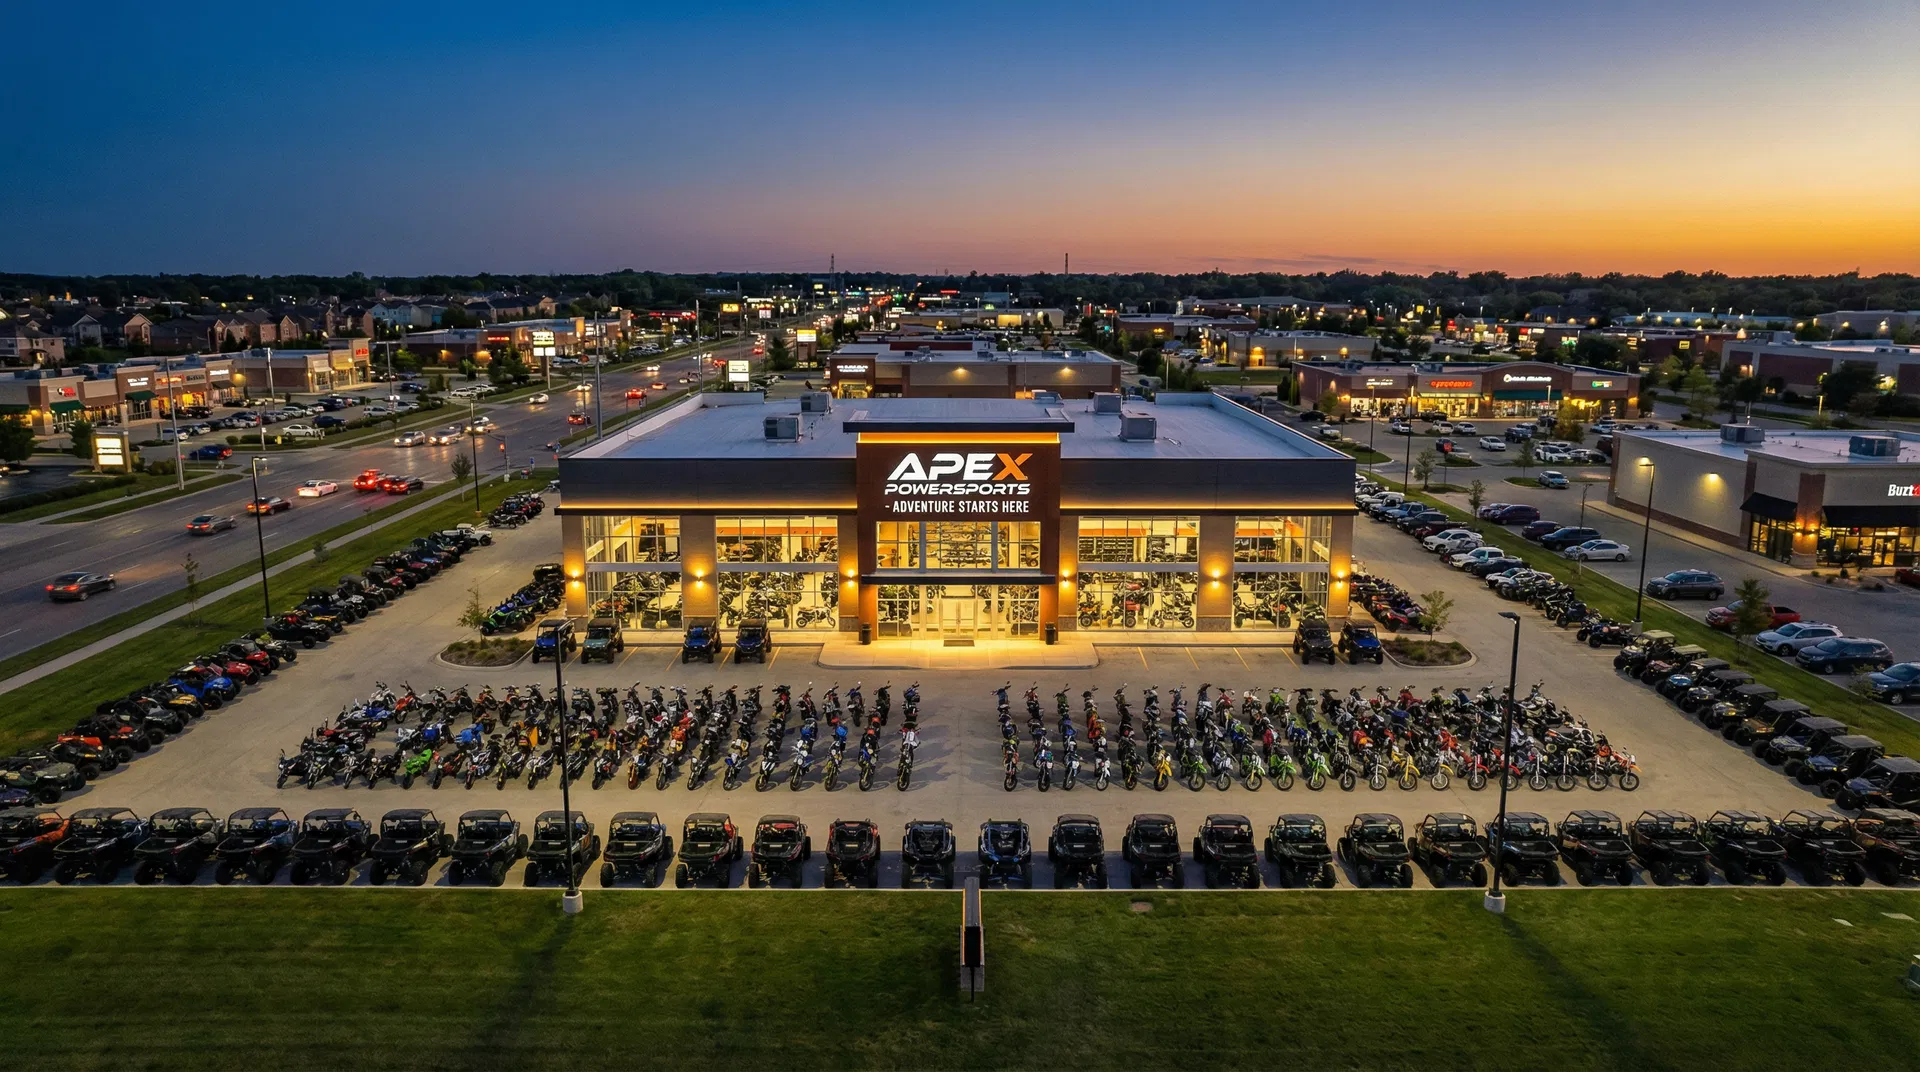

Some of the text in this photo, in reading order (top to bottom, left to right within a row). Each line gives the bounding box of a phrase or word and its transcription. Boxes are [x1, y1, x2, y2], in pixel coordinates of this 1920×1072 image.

[887, 453, 1033, 480] APEX
[885, 484, 1031, 495] POWERSPORTS
[893, 501, 954, 512] ADVENTURE
[958, 501, 998, 512] STARTS
[1002, 501, 1029, 512] HERE
